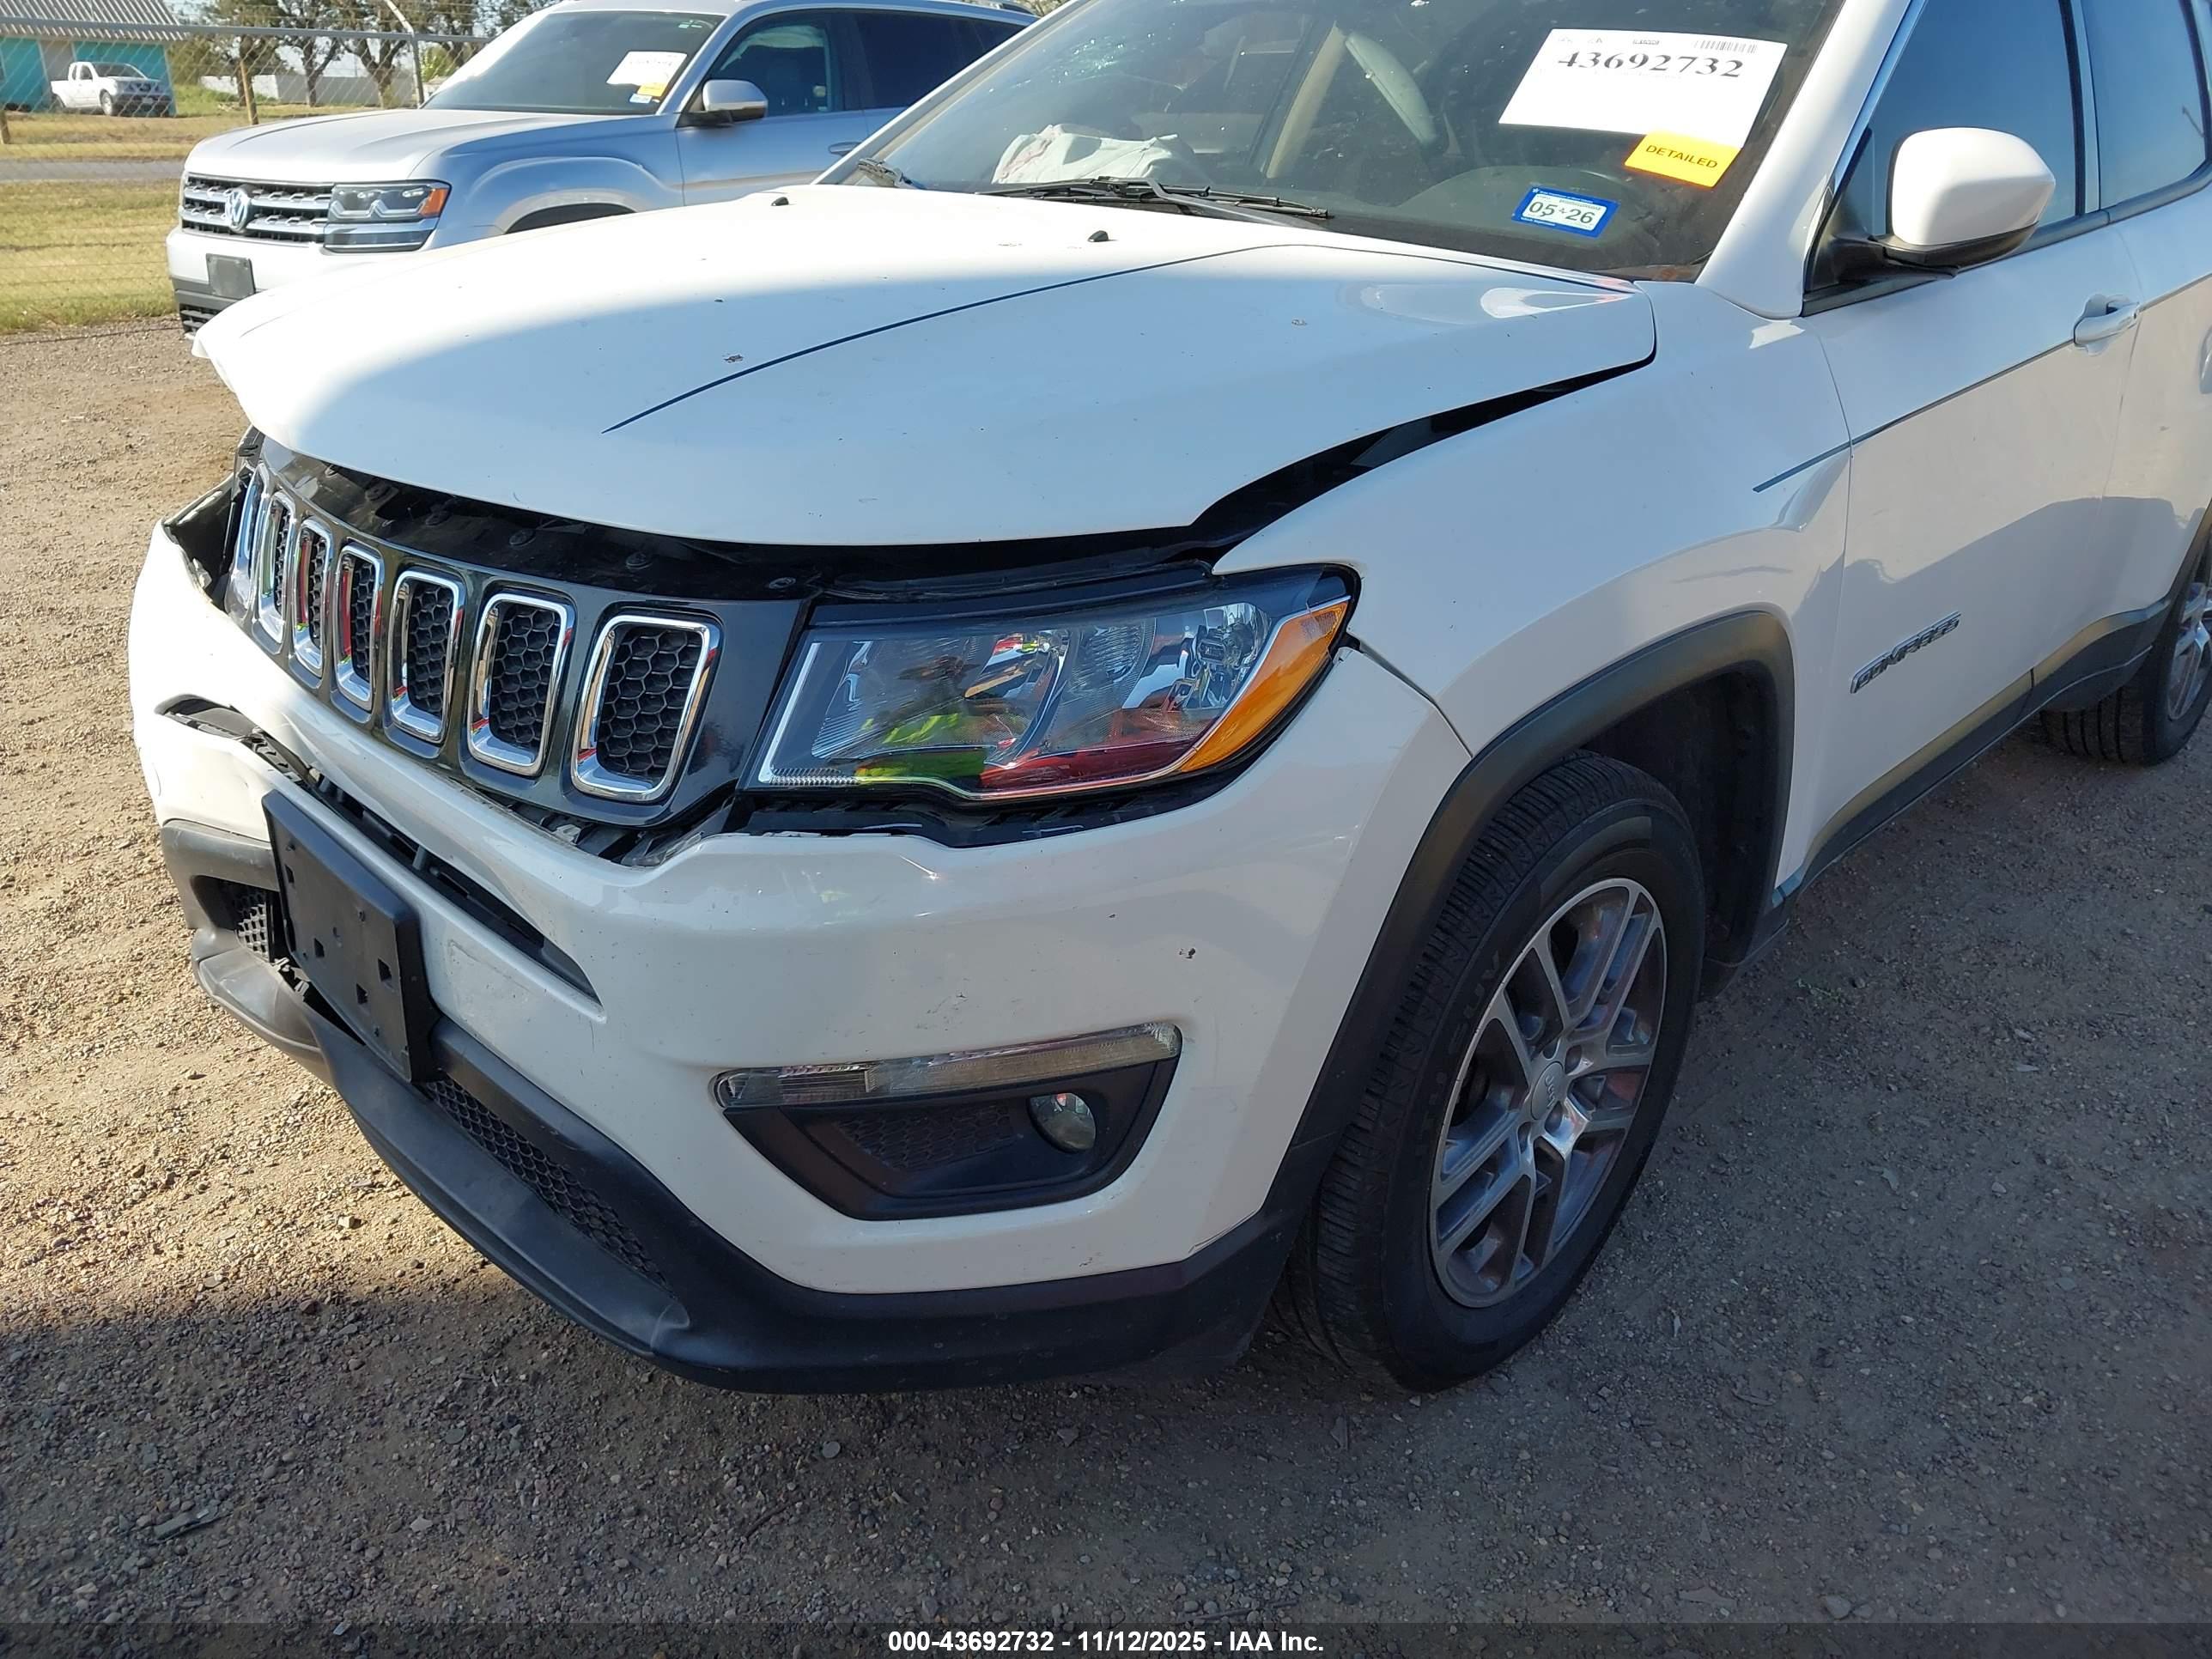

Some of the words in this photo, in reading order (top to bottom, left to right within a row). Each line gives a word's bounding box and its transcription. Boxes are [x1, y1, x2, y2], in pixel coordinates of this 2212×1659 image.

[1558, 50, 1743, 78] 43692732
[1645, 144, 1718, 168] DETAILED
[1528, 201, 1558, 217] 05
[1565, 209, 1595, 224] 26
